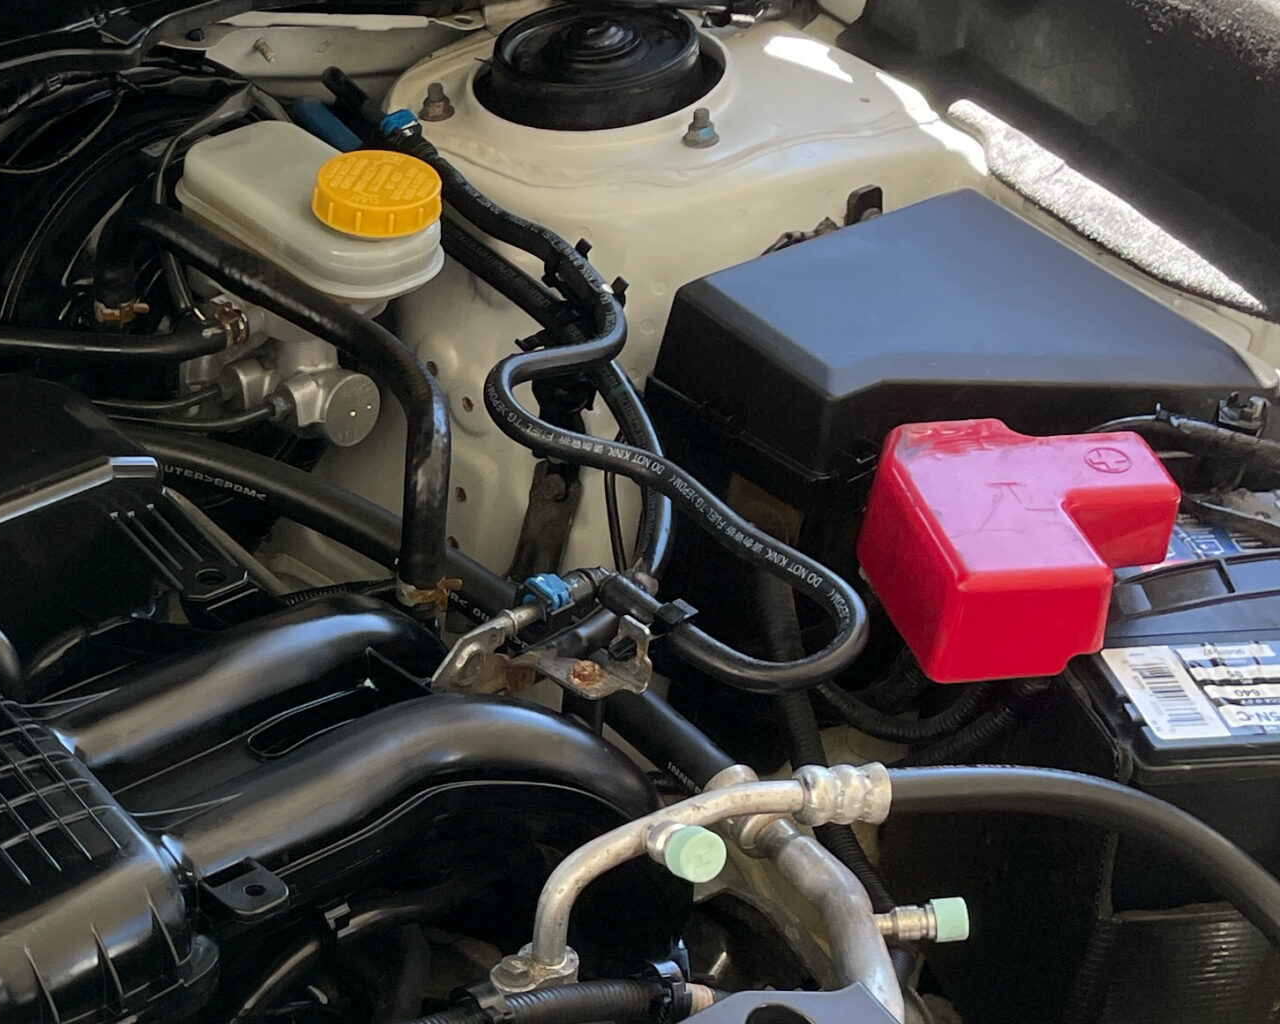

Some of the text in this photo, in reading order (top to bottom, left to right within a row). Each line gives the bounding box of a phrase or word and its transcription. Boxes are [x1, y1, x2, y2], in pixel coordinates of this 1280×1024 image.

[526, 424, 556, 442] FUEL
[632, 452, 654, 468] NOT
[652, 462, 666, 475] DO
[706, 508, 727, 530] FUEL
[786, 562, 808, 580] NOT
[807, 572, 822, 588] DO
